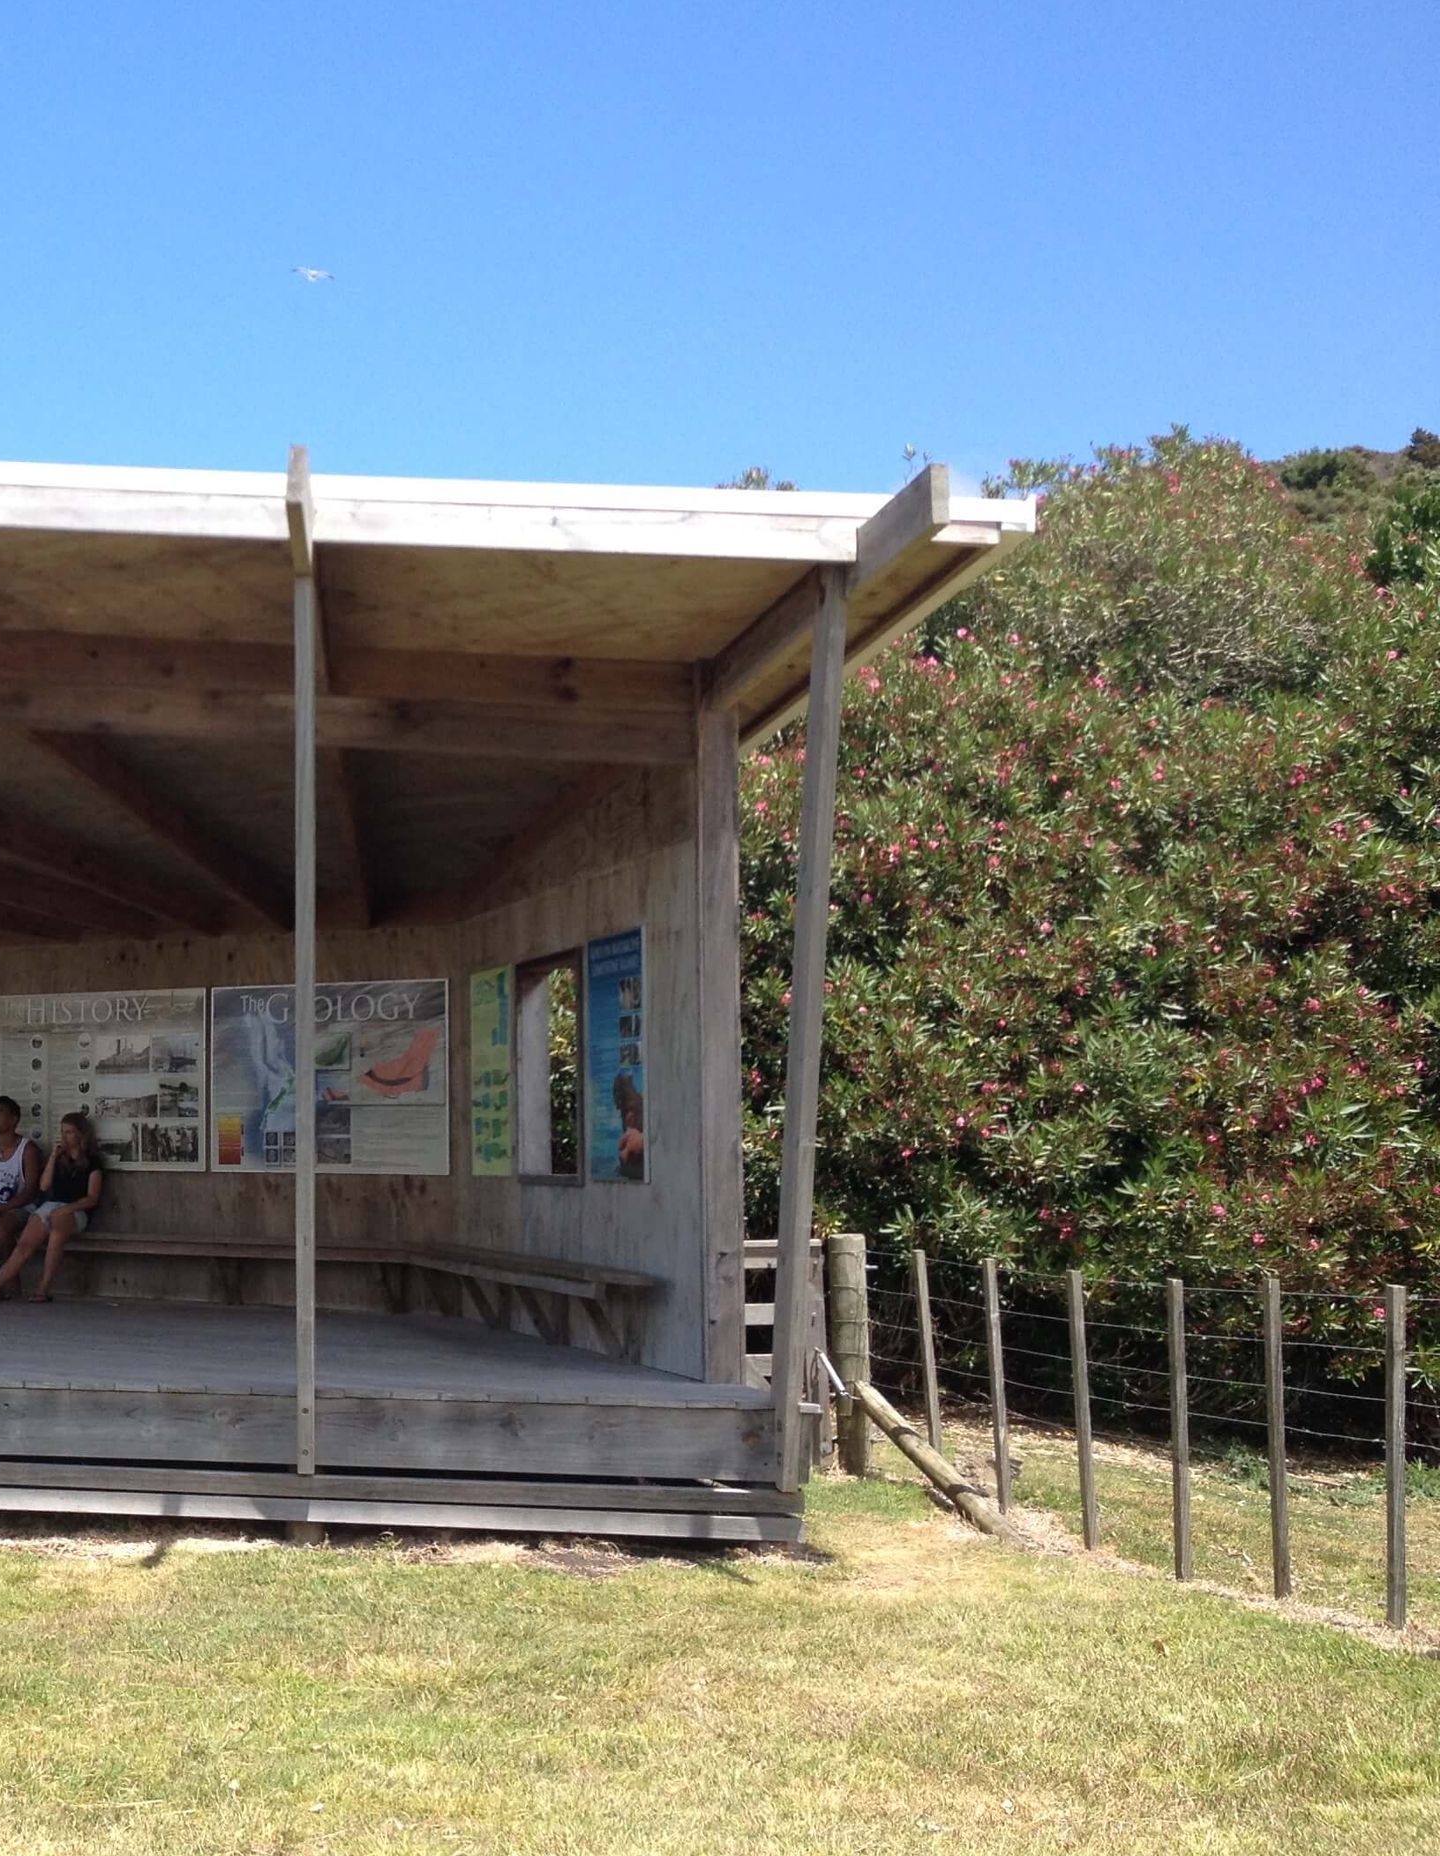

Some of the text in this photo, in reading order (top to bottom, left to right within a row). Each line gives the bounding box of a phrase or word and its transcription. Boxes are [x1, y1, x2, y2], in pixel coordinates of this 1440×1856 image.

[26, 997, 149, 1025] HISTORY
[240, 992, 422, 1025] The GOLOGY
